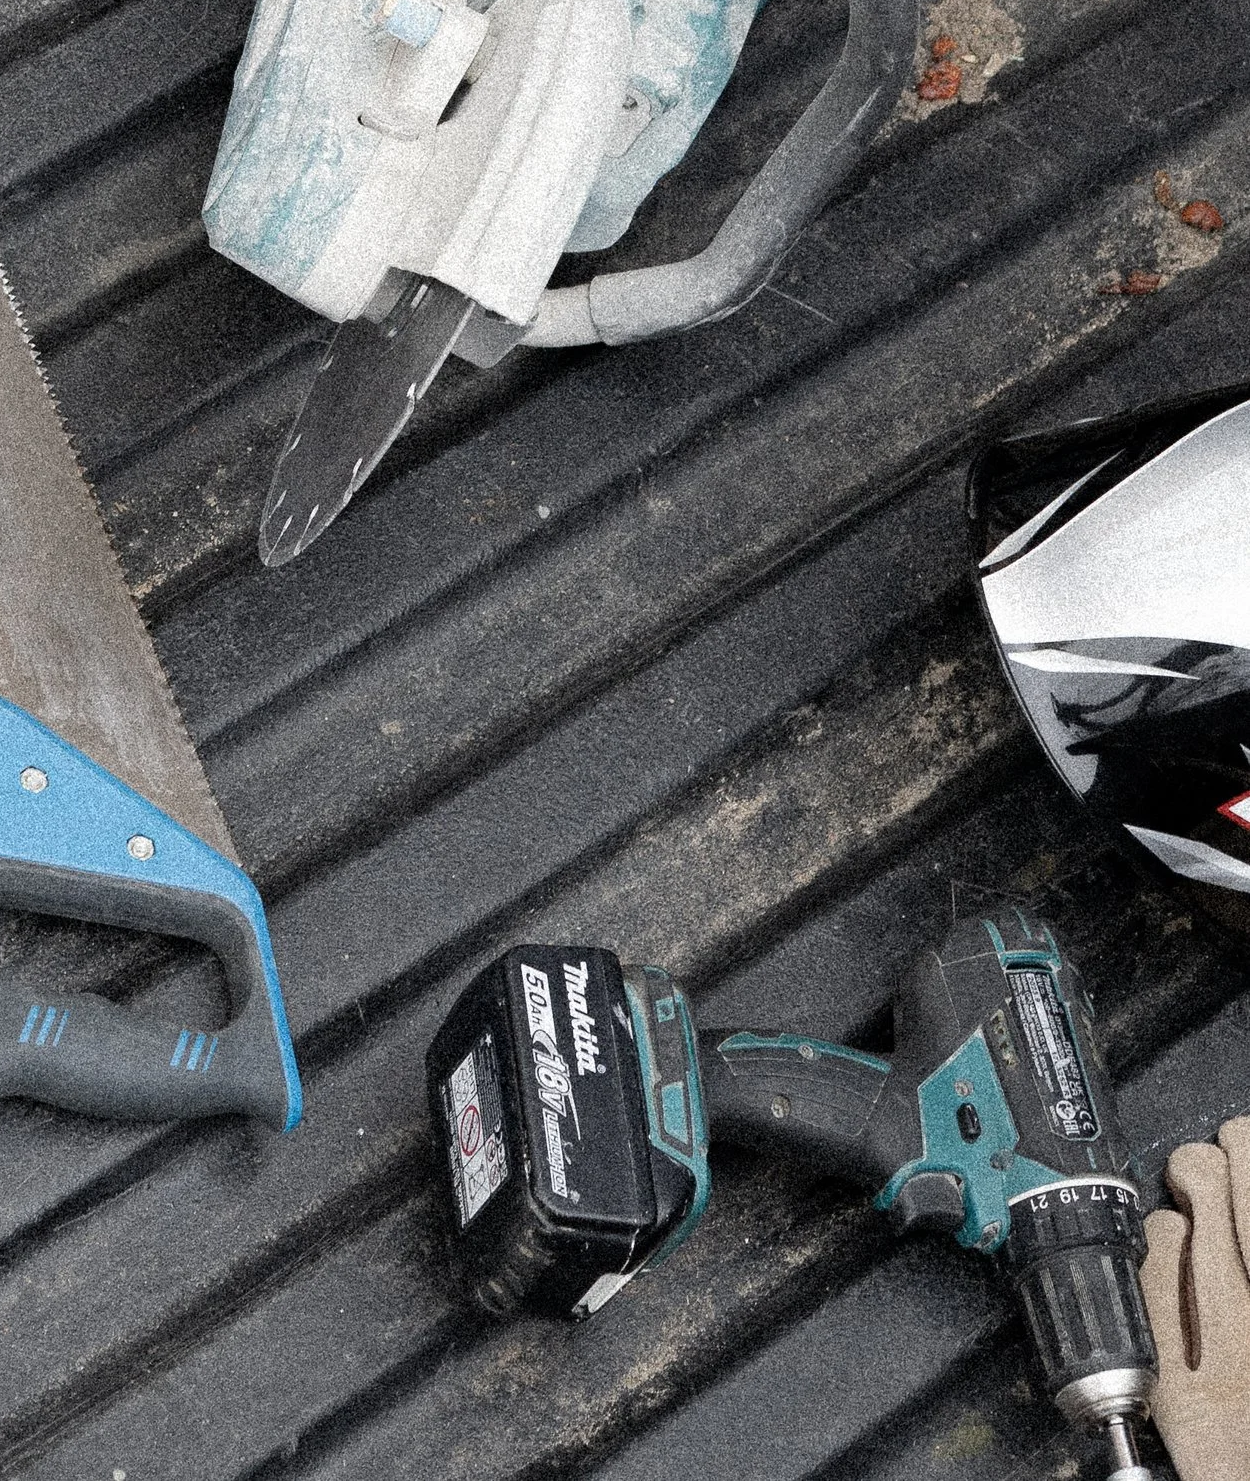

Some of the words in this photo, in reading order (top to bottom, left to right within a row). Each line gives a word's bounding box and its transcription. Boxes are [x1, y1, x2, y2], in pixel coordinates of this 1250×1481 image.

[1059, 1187, 1079, 1204] 19
[1091, 1186, 1108, 1201] 17
[1116, 1189, 1130, 1204] 15
[1030, 1194, 1048, 1213] 21
